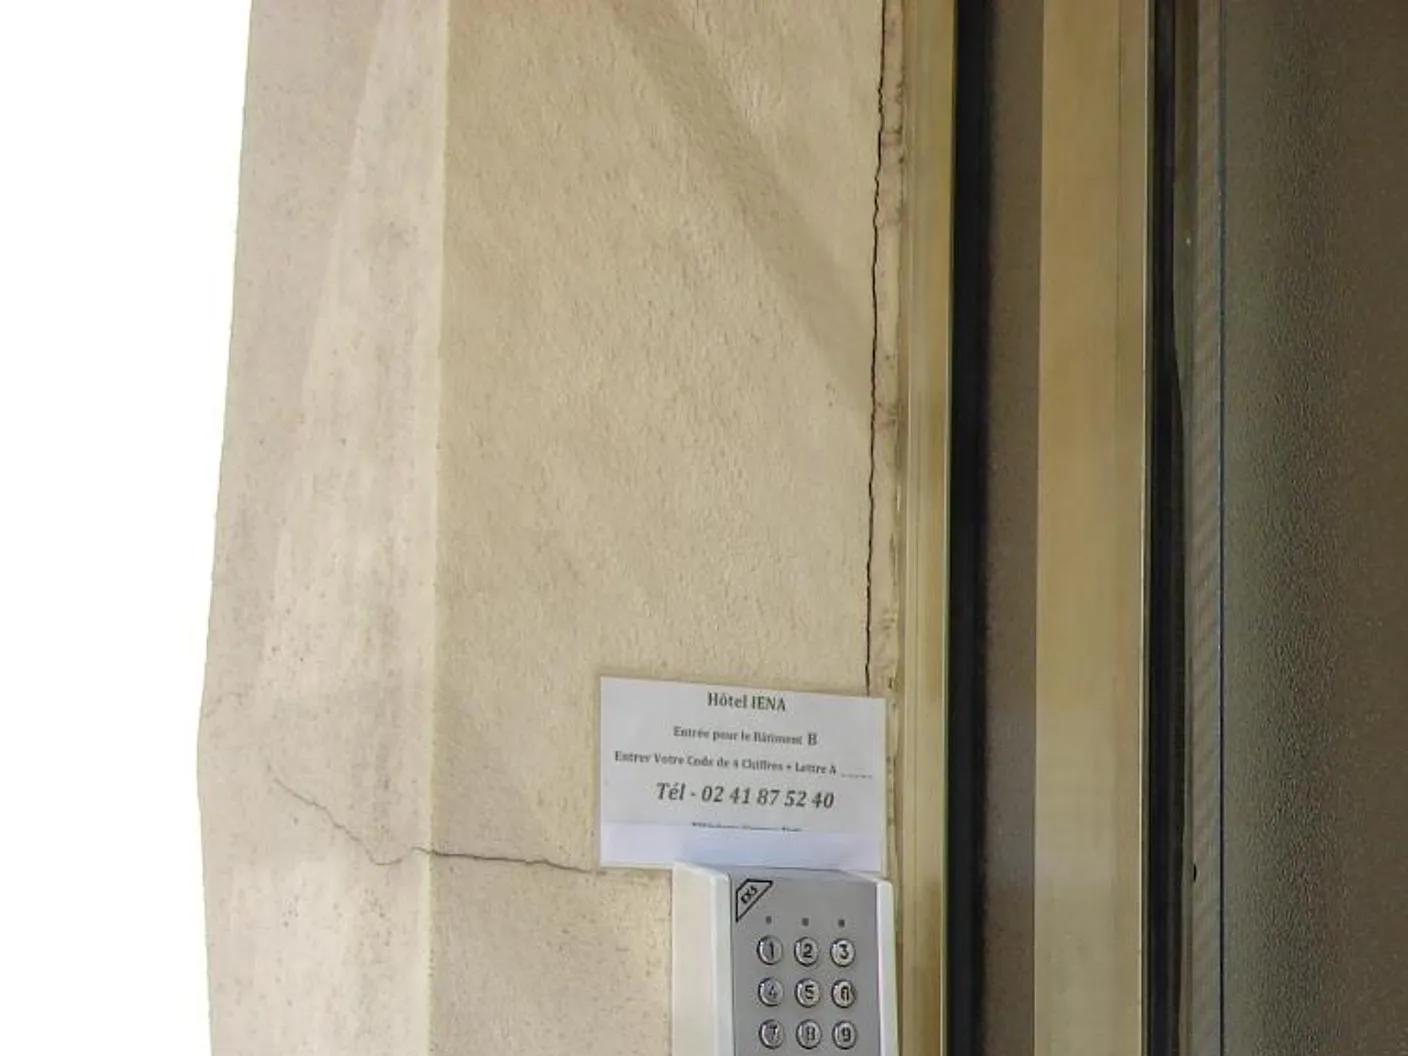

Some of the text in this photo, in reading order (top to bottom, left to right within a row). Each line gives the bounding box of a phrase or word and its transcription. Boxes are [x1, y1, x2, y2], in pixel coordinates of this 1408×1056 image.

[707, 691, 787, 712] Hôtel IENA
[673, 725, 818, 747] Entrée pour le Bâtiment B
[614, 750, 651, 764] Entrer
[653, 752, 685, 766] Votre
[686, 755, 715, 768] Code
[716, 756, 731, 769] de
[741, 758, 784, 772] Chiffres
[795, 762, 827, 776] Lettre
[828, 764, 837, 776] A
[656, 782, 685, 802] Tél
[701, 785, 724, 804] 02
[729, 787, 751, 805] 41
[756, 788, 780, 807] 87
[784, 789, 806, 808] 52
[811, 791, 835, 810] 40
